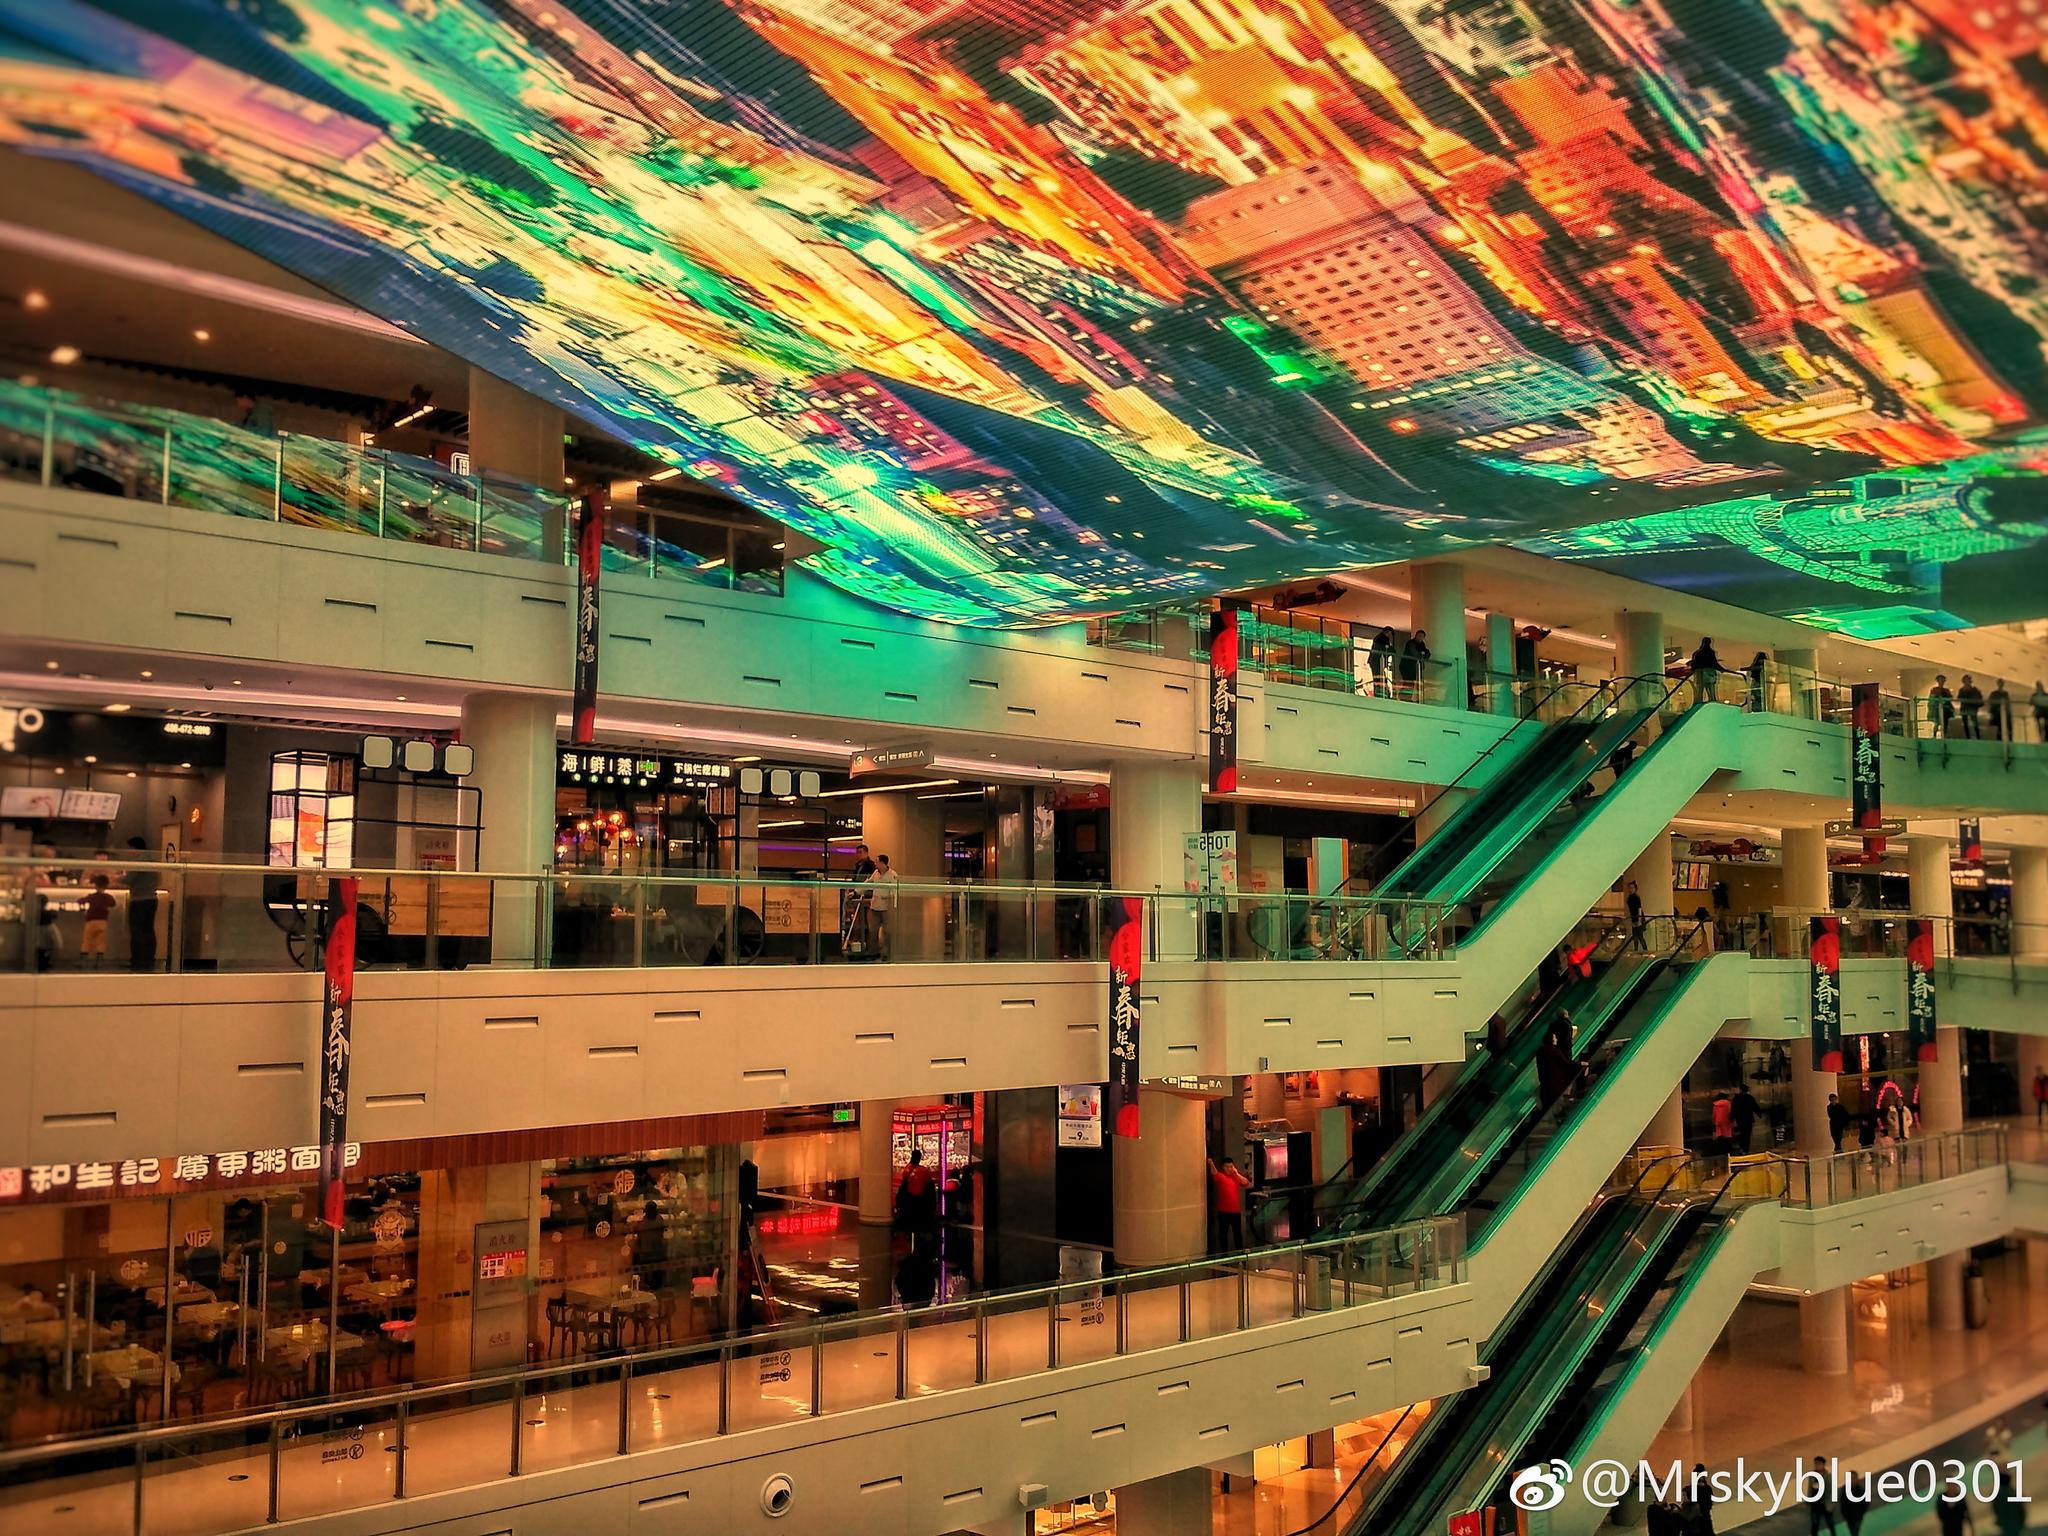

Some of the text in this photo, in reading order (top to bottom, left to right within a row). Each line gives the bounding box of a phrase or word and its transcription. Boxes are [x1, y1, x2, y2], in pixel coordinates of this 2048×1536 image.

[562, 753, 657, 779] 海鲜蒸
[29, 1158, 161, 1194] 和生記
